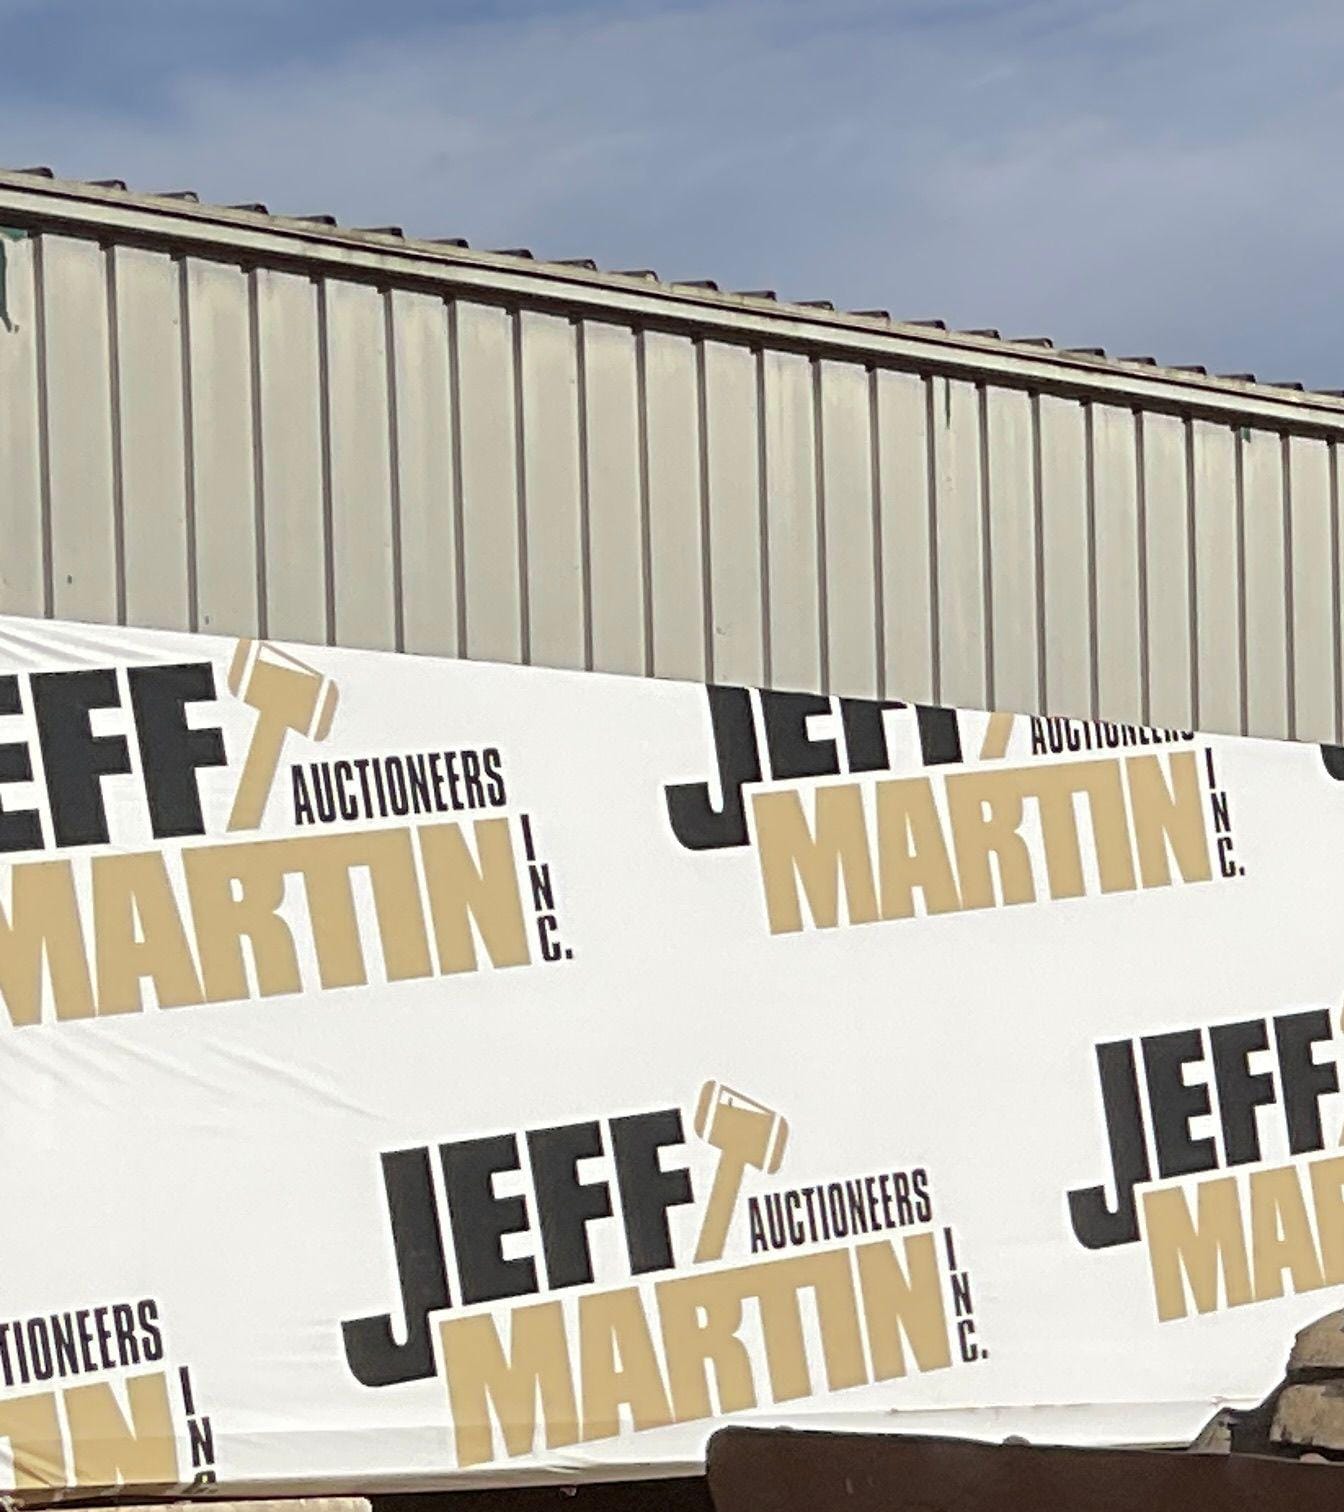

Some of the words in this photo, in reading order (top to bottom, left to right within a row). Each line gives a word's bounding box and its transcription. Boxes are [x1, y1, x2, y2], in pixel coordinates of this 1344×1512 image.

[290, 747, 507, 826] AUCTIONEERS
[751, 749, 1213, 935] MARTIN
[1205, 747, 1246, 877] INC.
[520, 813, 574, 962] INC.
[1066, 1008, 1340, 1250] JEFF
[341, 1106, 695, 1388] JEFF
[747, 1167, 933, 1254] AUCTIONEERS
[438, 1230, 953, 1468] MARTIN
[942, 1227, 989, 1364] INC.
